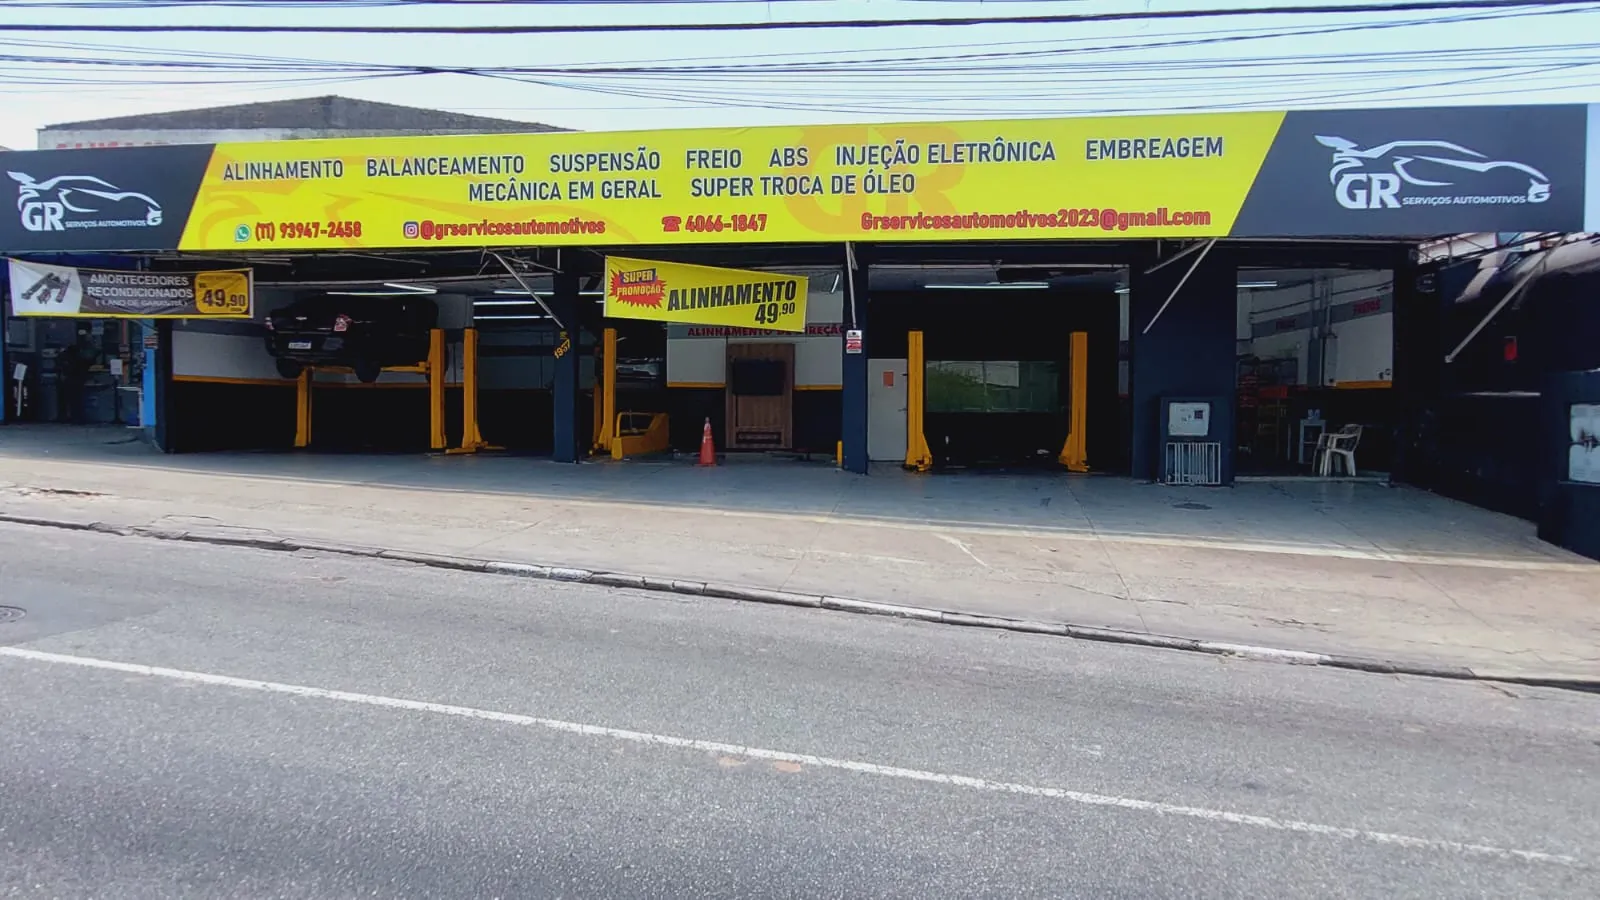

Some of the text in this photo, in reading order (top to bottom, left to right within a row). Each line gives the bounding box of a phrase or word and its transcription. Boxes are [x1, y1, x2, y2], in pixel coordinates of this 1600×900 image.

[223, 136, 1223, 180] ALINHAMENTO BALANCEAMENTO SUSPENSÃO FREIO ABS INJEÇÃO ELETRÔNICA EMBREAGEM
[469, 168, 915, 202] MECÂNICA EM GERAL SUPER TROCA DE ÓLEO
[1335, 173, 1402, 209] GR
[1402, 195, 1526, 207] SERVIÇOS AUTOMOTIVOS
[21, 201, 65, 231] GR
[65, 219, 147, 229] SERVIÇOS AUTOMOTIVOS
[685, 213, 768, 232] 4066-1847
[861, 207, 1211, 232] Grservicosautomotivos2023@gmail.com
[255, 221, 362, 241] (11) 93947-2458
[421, 218, 606, 240] @grservicosautomotivos
[90, 273, 190, 286] AMORTECEDORES
[623, 271, 653, 284] SUPER
[87, 286, 194, 299] RECONDICIONADOS
[202, 288, 246, 308] 49,90
[616, 283, 661, 297] PROMOÇÃO
[667, 280, 797, 312] ALINHAMENTO
[687, 327, 772, 337] ALINHAMENTO
